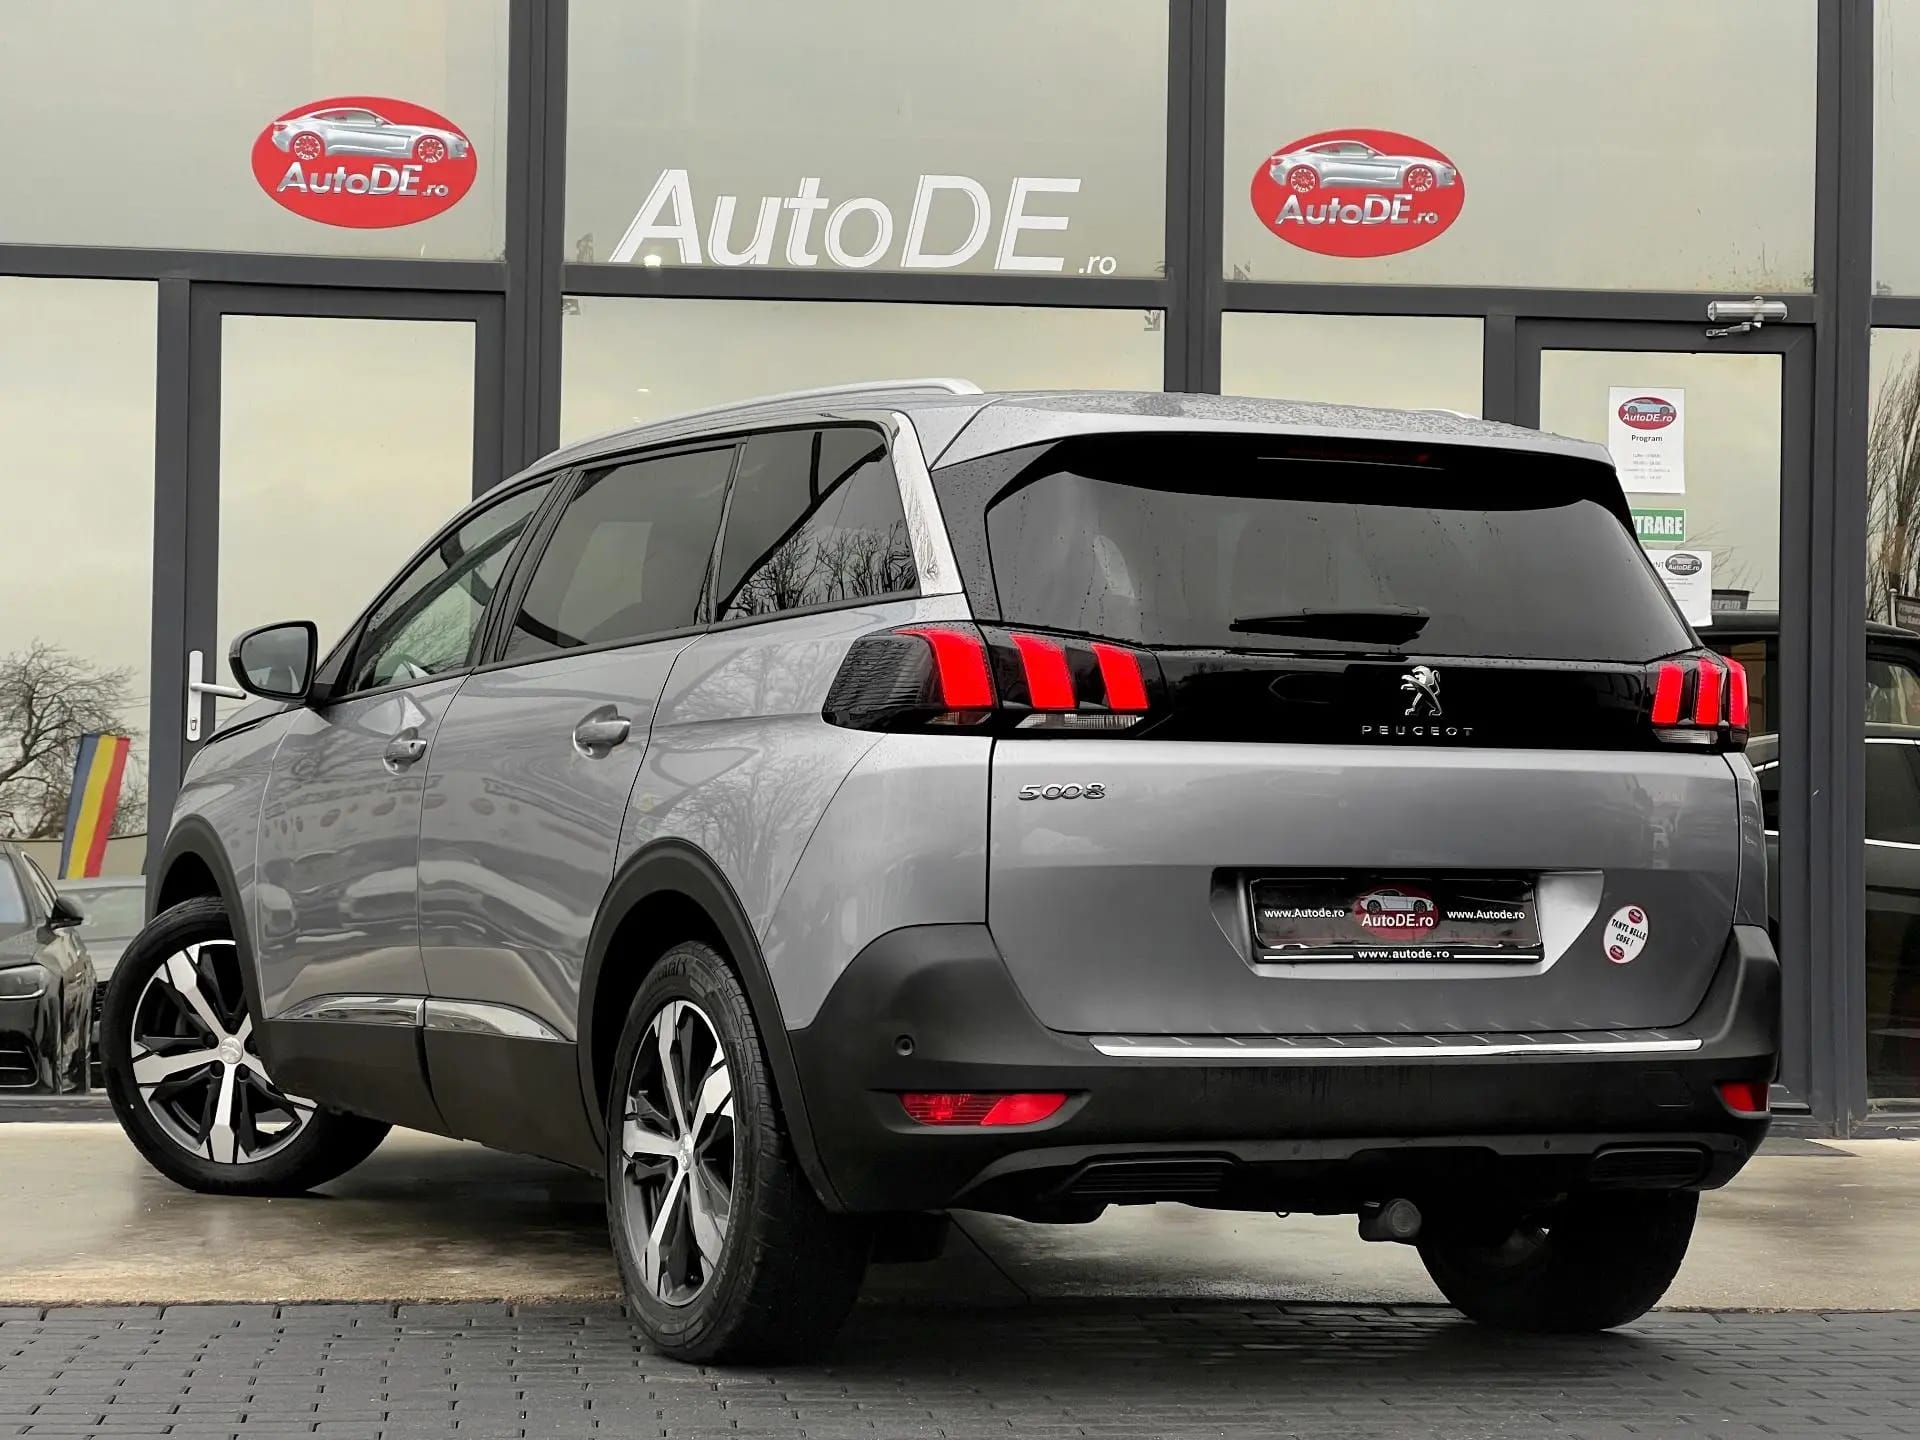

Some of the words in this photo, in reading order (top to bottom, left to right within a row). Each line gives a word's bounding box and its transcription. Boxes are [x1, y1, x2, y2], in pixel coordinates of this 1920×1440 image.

[1622, 413, 1673, 423] AutoDE.ro
[1631, 434, 1663, 443] Program
[1361, 725, 1474, 737] PEUGEOT
[1017, 782, 1106, 801] 5008
[1264, 907, 1345, 919] www.Autode.ro
[1447, 909, 1526, 920] www.Autode.ro
[1361, 913, 1434, 928] AutoDE.ro
[1611, 918, 1629, 933] TANTE
[1629, 927, 1647, 941] BELLE
[1357, 949, 1450, 960] www.autode.ro
